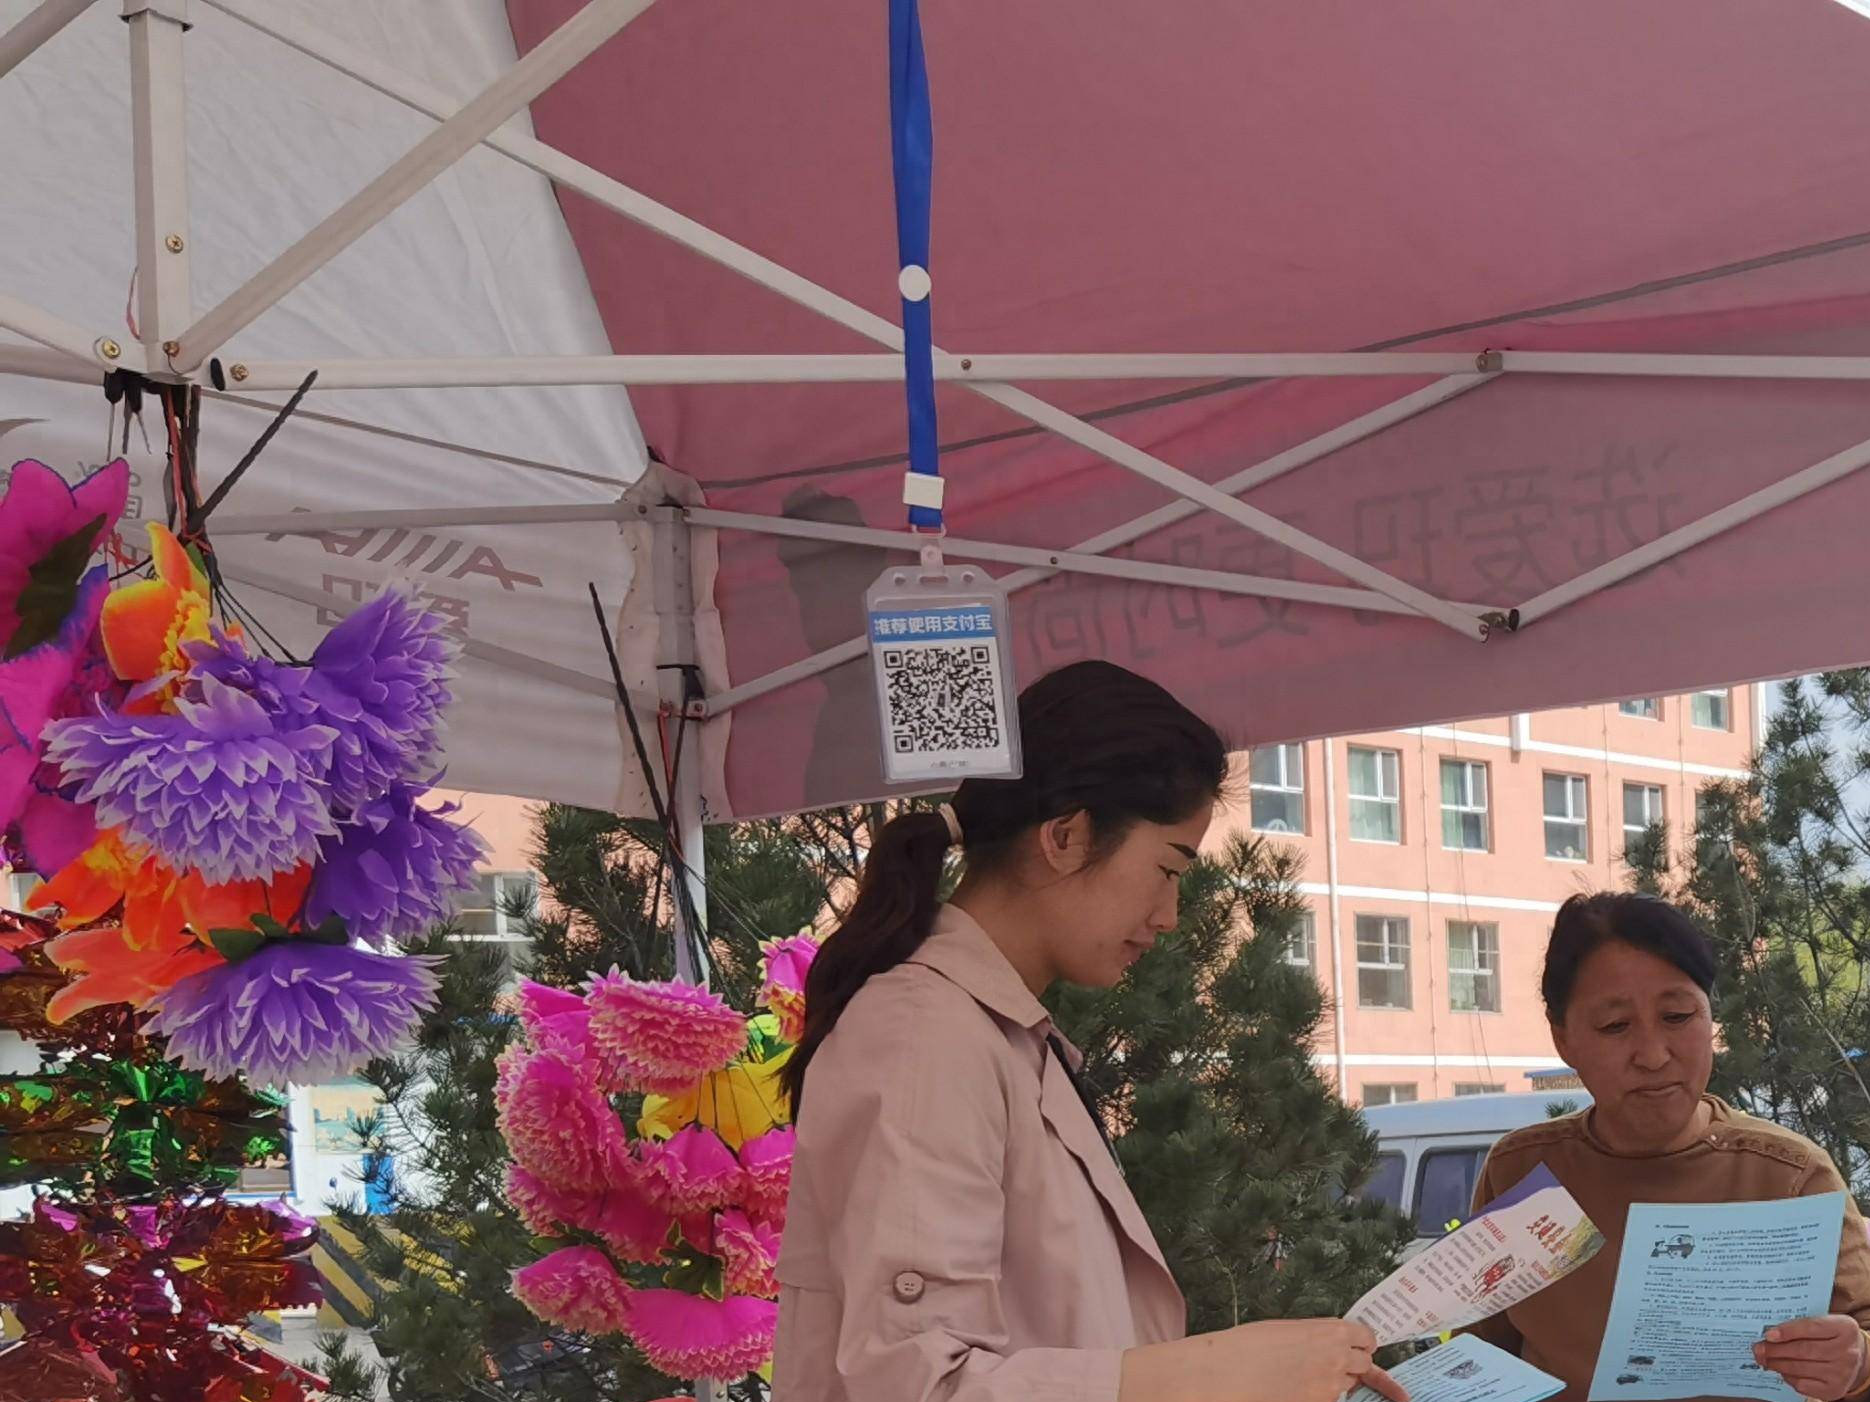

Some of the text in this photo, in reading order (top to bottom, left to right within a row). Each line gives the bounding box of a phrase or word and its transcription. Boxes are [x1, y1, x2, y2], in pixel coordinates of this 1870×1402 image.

[873, 613, 993, 635] 推荐使用支付宝
